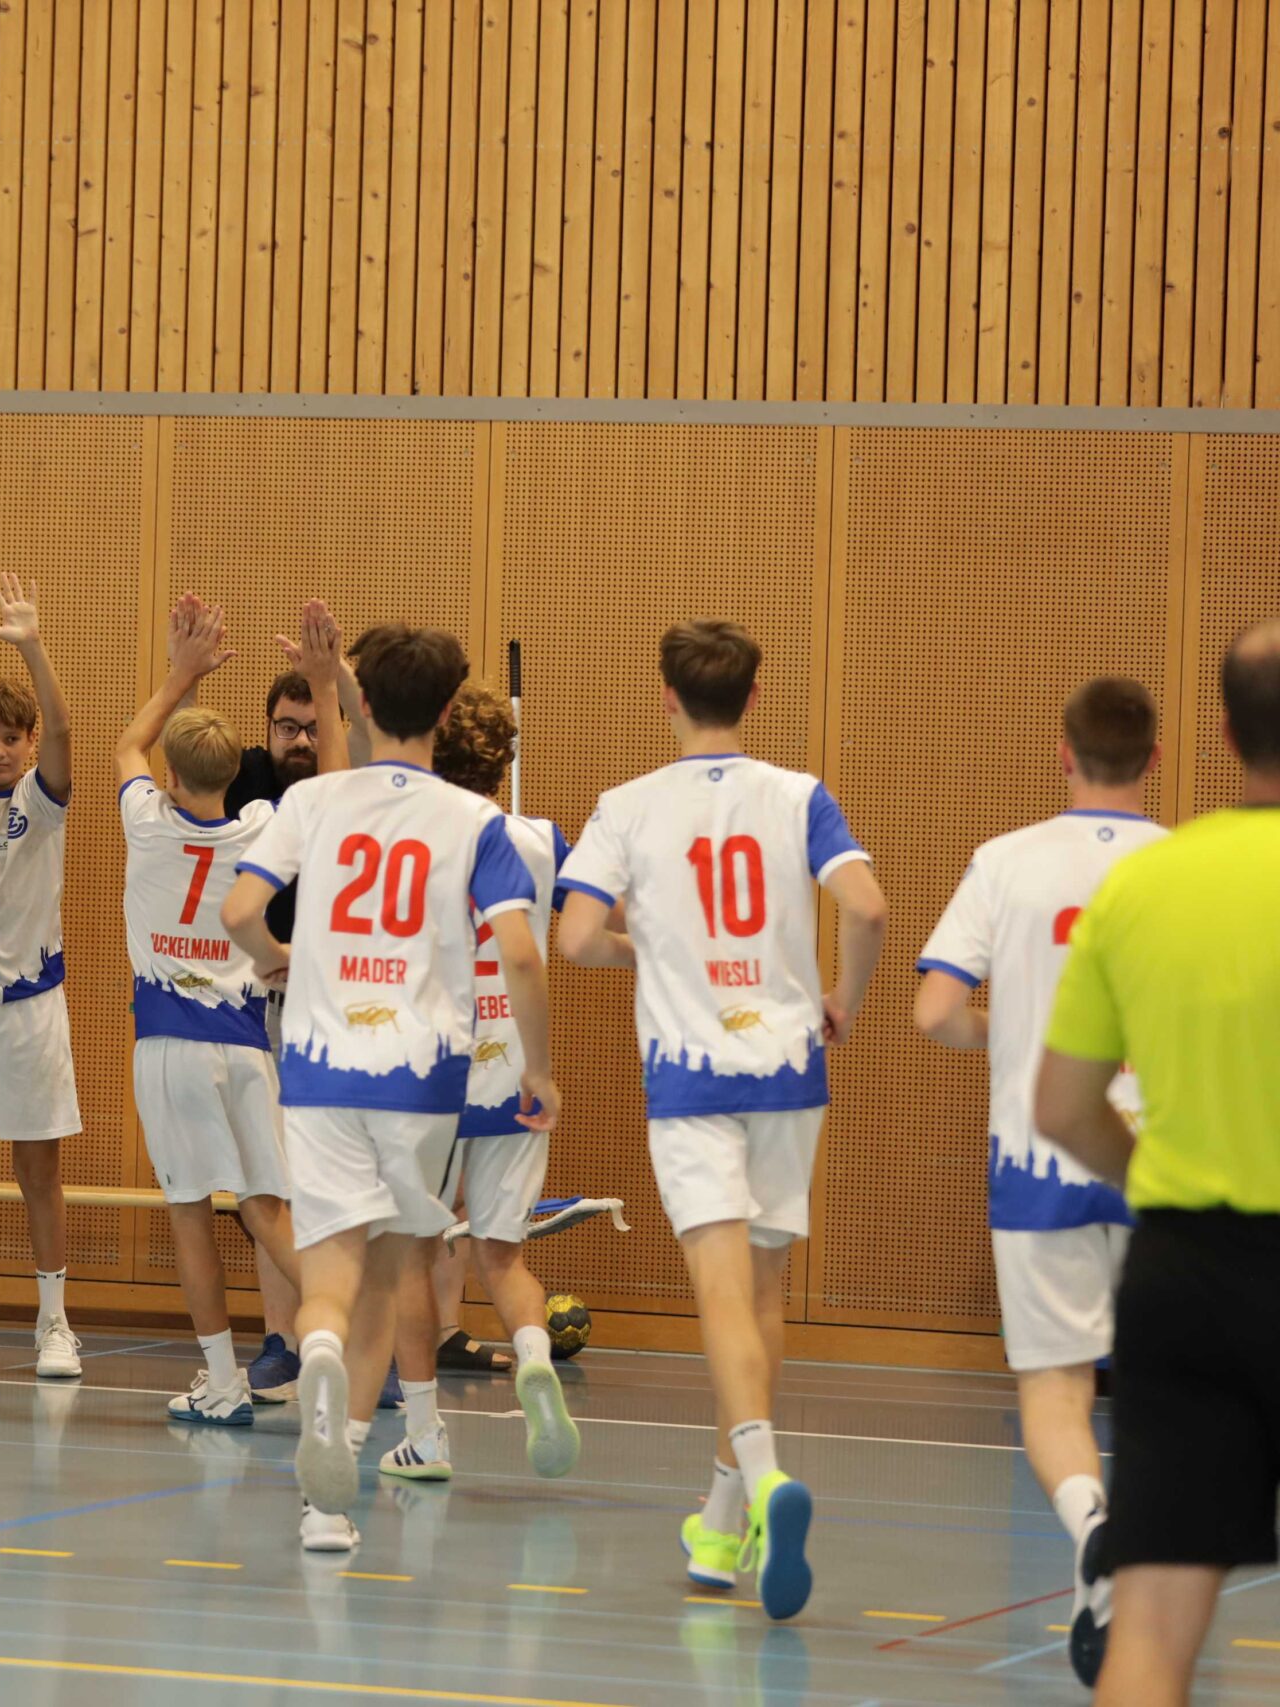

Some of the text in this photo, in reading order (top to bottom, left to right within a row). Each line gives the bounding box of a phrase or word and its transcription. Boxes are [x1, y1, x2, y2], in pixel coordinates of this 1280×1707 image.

[179, 844, 214, 925] 7
[330, 833, 431, 937] 20
[686, 834, 765, 939] 10
[151, 933, 231, 961] UCKELMANN
[340, 955, 407, 985] MADER
[705, 959, 760, 987] WIESLI
[478, 994, 513, 1020] EBE
